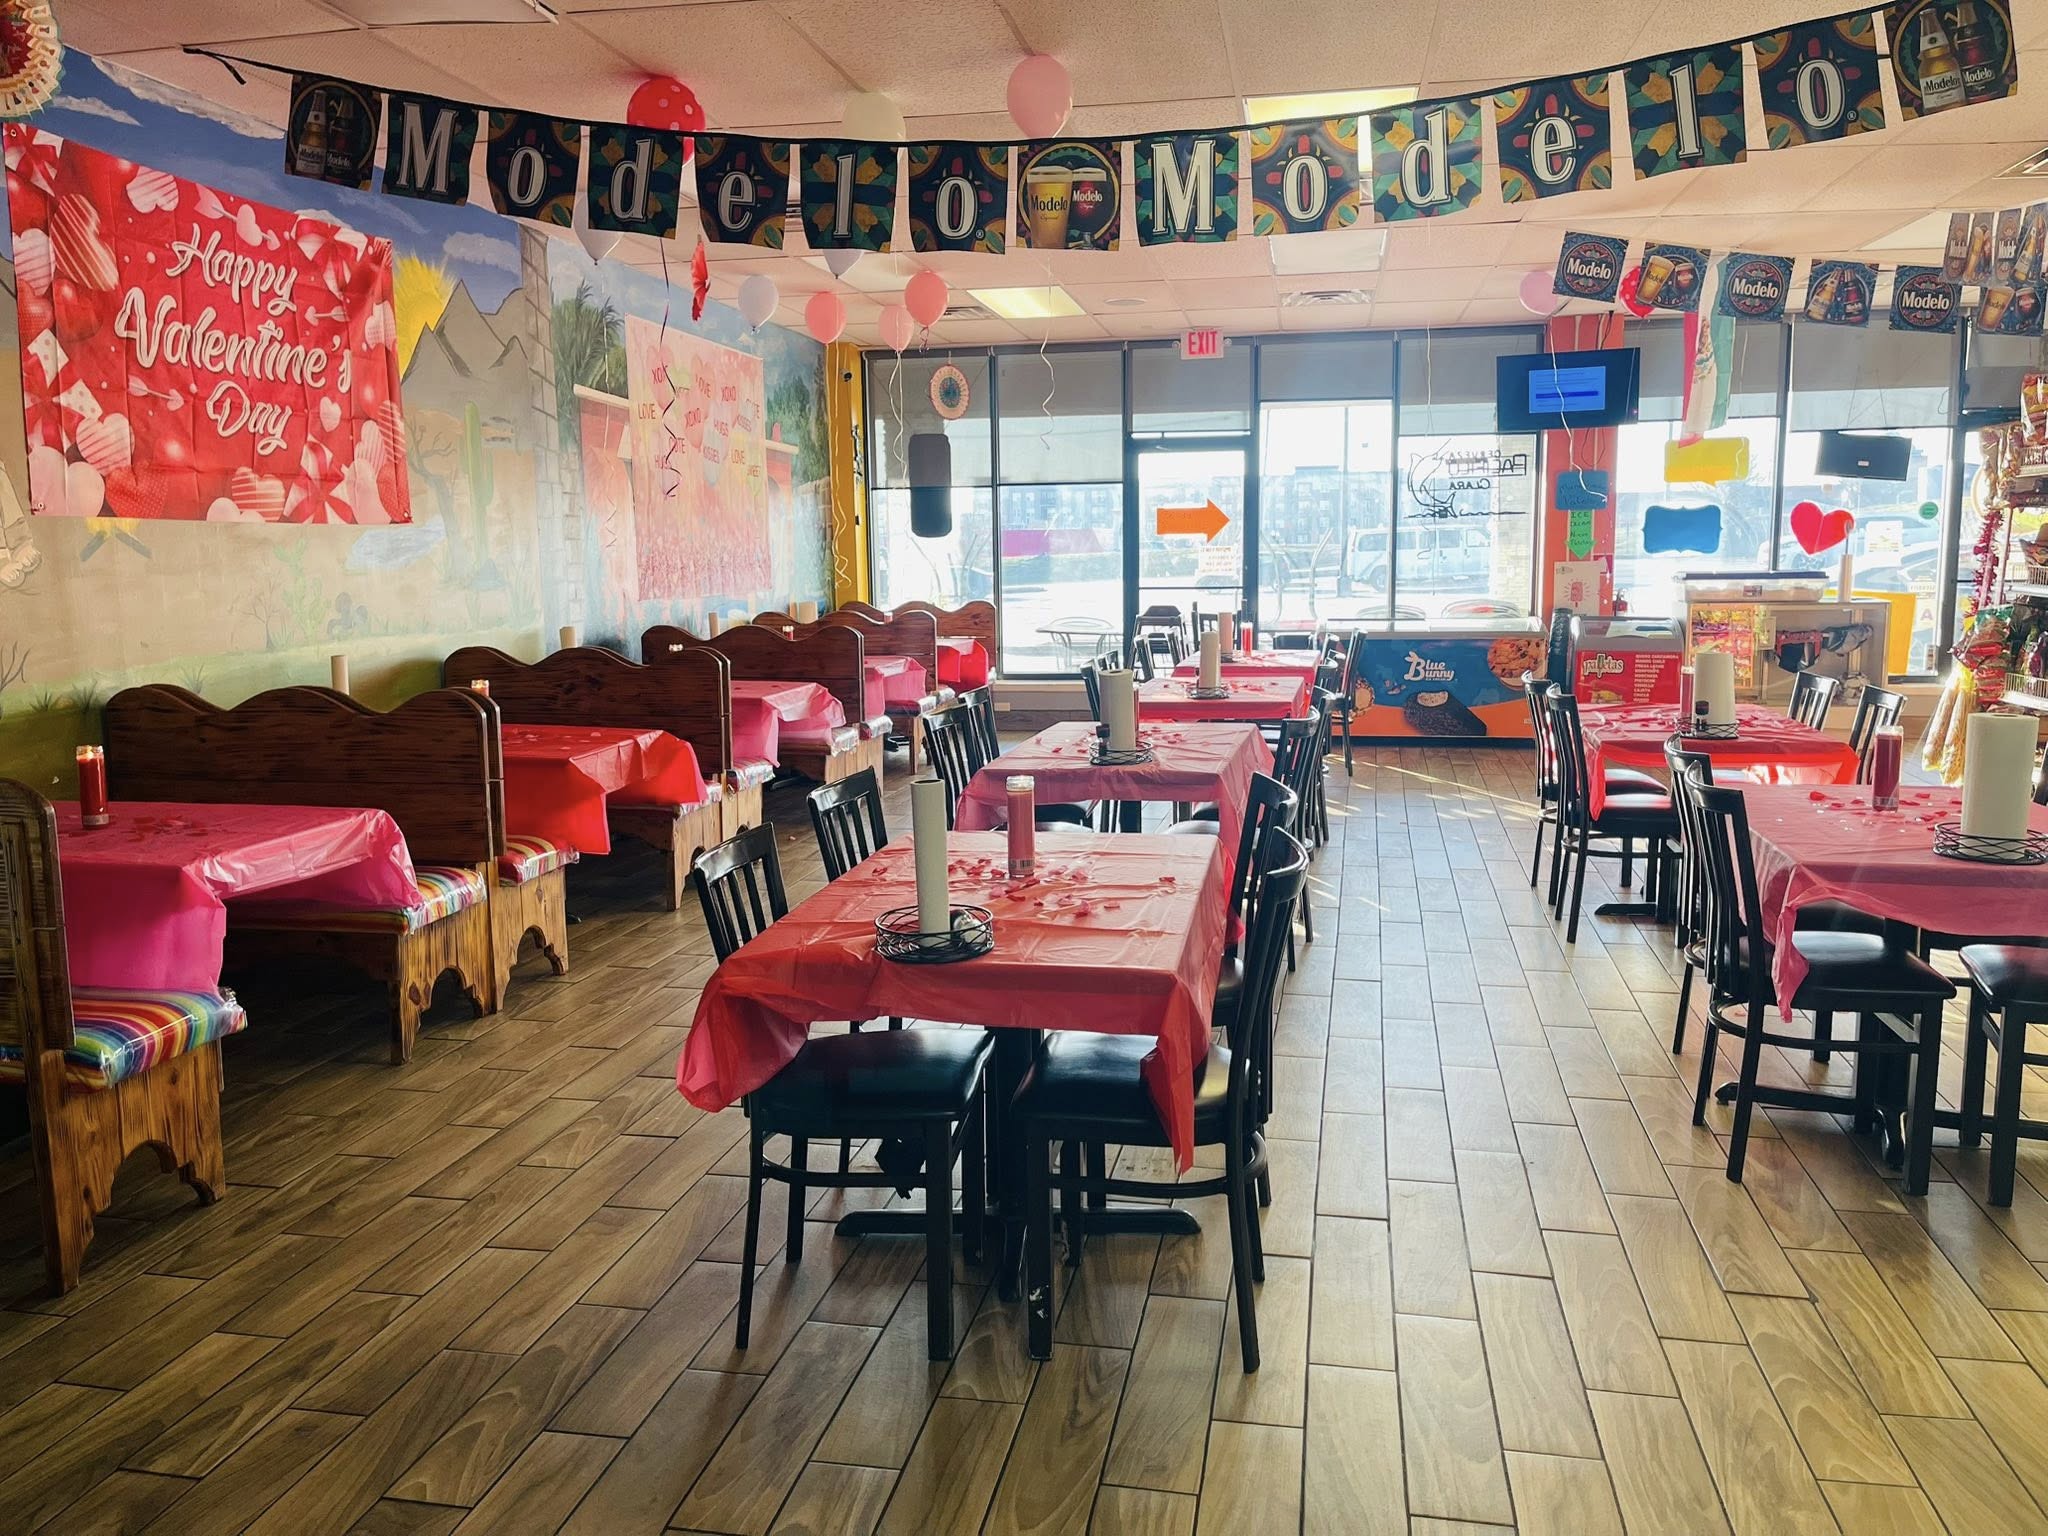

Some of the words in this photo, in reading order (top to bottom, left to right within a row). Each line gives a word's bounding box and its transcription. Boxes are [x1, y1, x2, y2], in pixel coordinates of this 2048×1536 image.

[1924, 75, 1958, 92] Modelo
[1031, 192, 1068, 212] Modelo
[1073, 190, 1103, 202] Modelo
[165, 222, 298, 316] Happy
[1567, 257, 1611, 280] Modelo
[1732, 277, 1778, 299] Modelo
[1902, 291, 1949, 311] Modelo
[115, 286, 352, 394] Valentine's
[1188, 331, 1217, 355] EXIT
[206, 380, 292, 456] Day
[638, 403, 656, 420] LOVE
